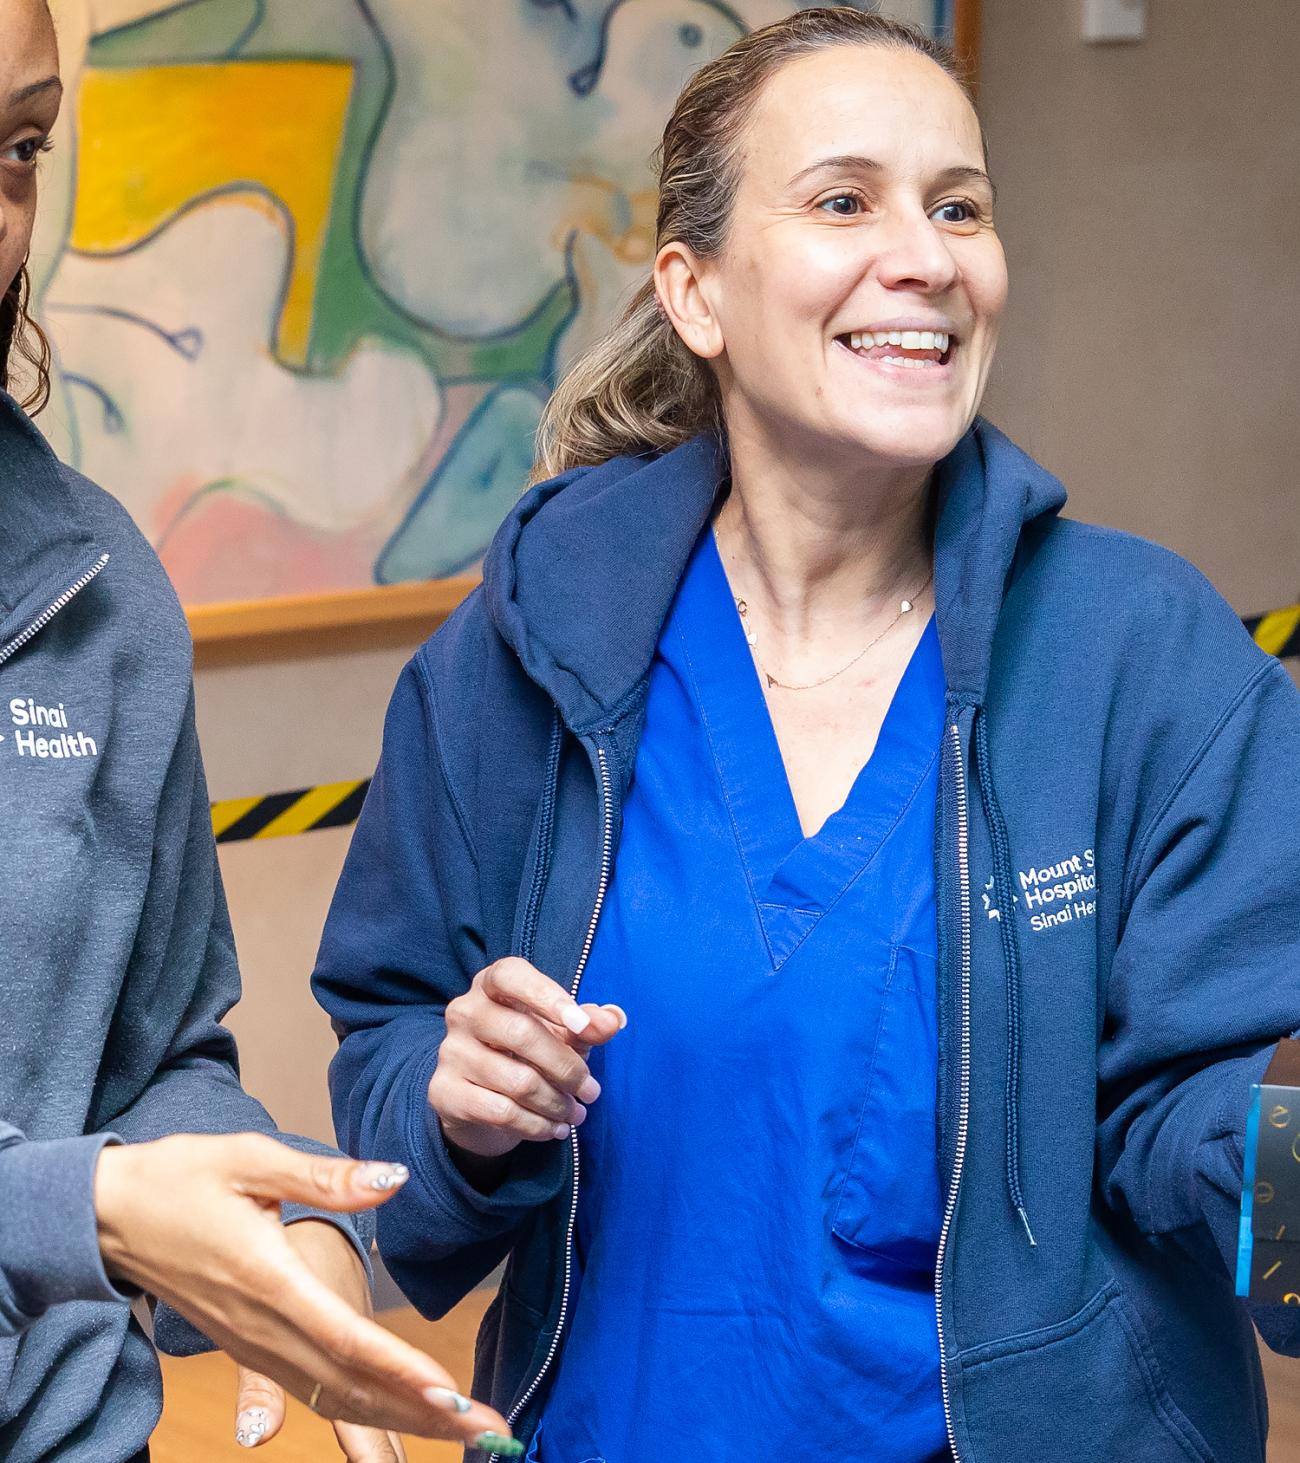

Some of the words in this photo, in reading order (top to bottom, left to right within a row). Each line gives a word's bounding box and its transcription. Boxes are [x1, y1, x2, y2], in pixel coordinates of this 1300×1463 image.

[9, 698, 68, 728] Sinai
[14, 729, 98, 759] Health
[1018, 854, 1083, 890] Mount
[1083, 849, 1095, 868] S
[1024, 869, 1096, 910] Hospita
[1030, 903, 1073, 932] Sinai
